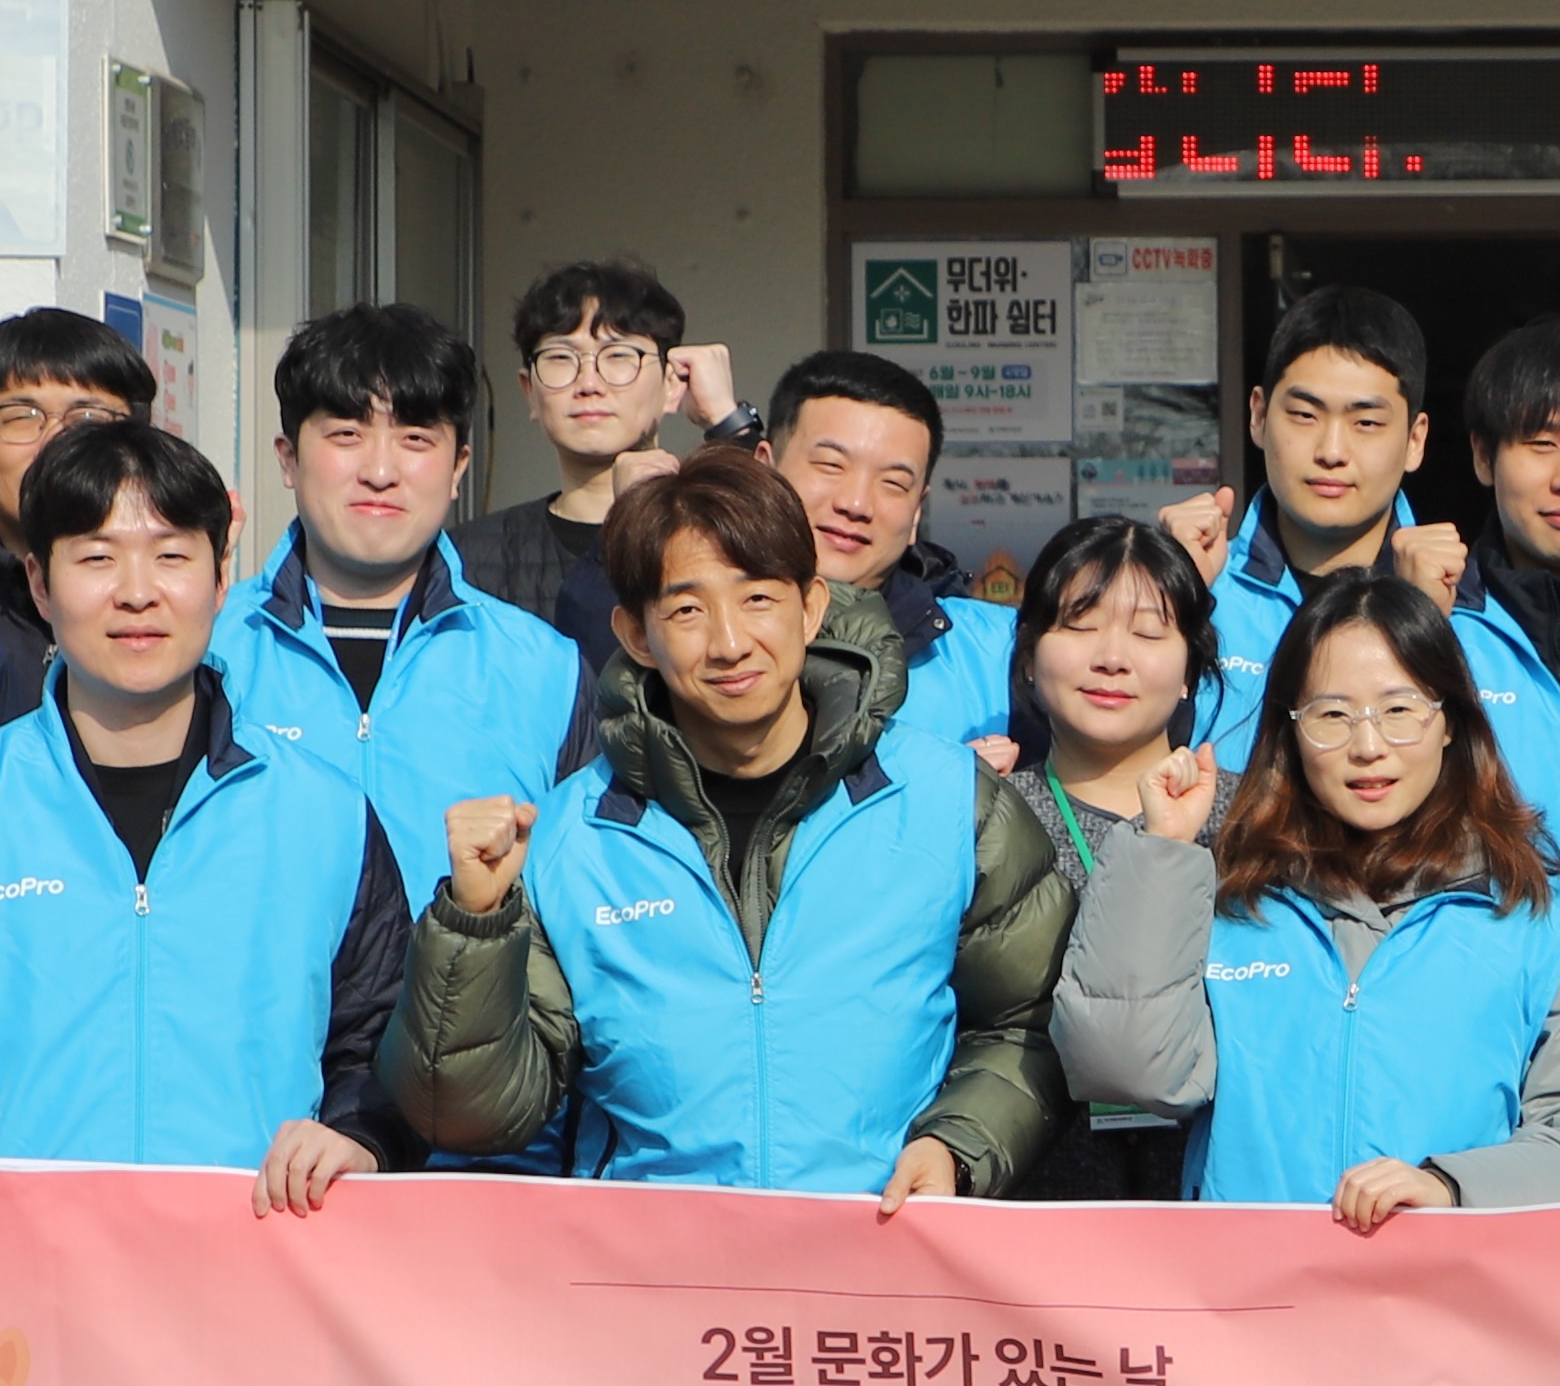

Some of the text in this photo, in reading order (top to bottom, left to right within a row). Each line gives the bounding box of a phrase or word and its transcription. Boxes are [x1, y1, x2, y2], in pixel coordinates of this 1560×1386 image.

[946, 299, 997, 336] 한파
[1006, 299, 1057, 336] 쉼터
[929, 365, 954, 380] 6월
[971, 365, 995, 380] 9월
[965, 384, 1031, 399] 9시-18시
[594, 896, 675, 925] EcoPro
[1205, 961, 1290, 982] EcoPro
[701, 1326, 795, 1386] 2월
